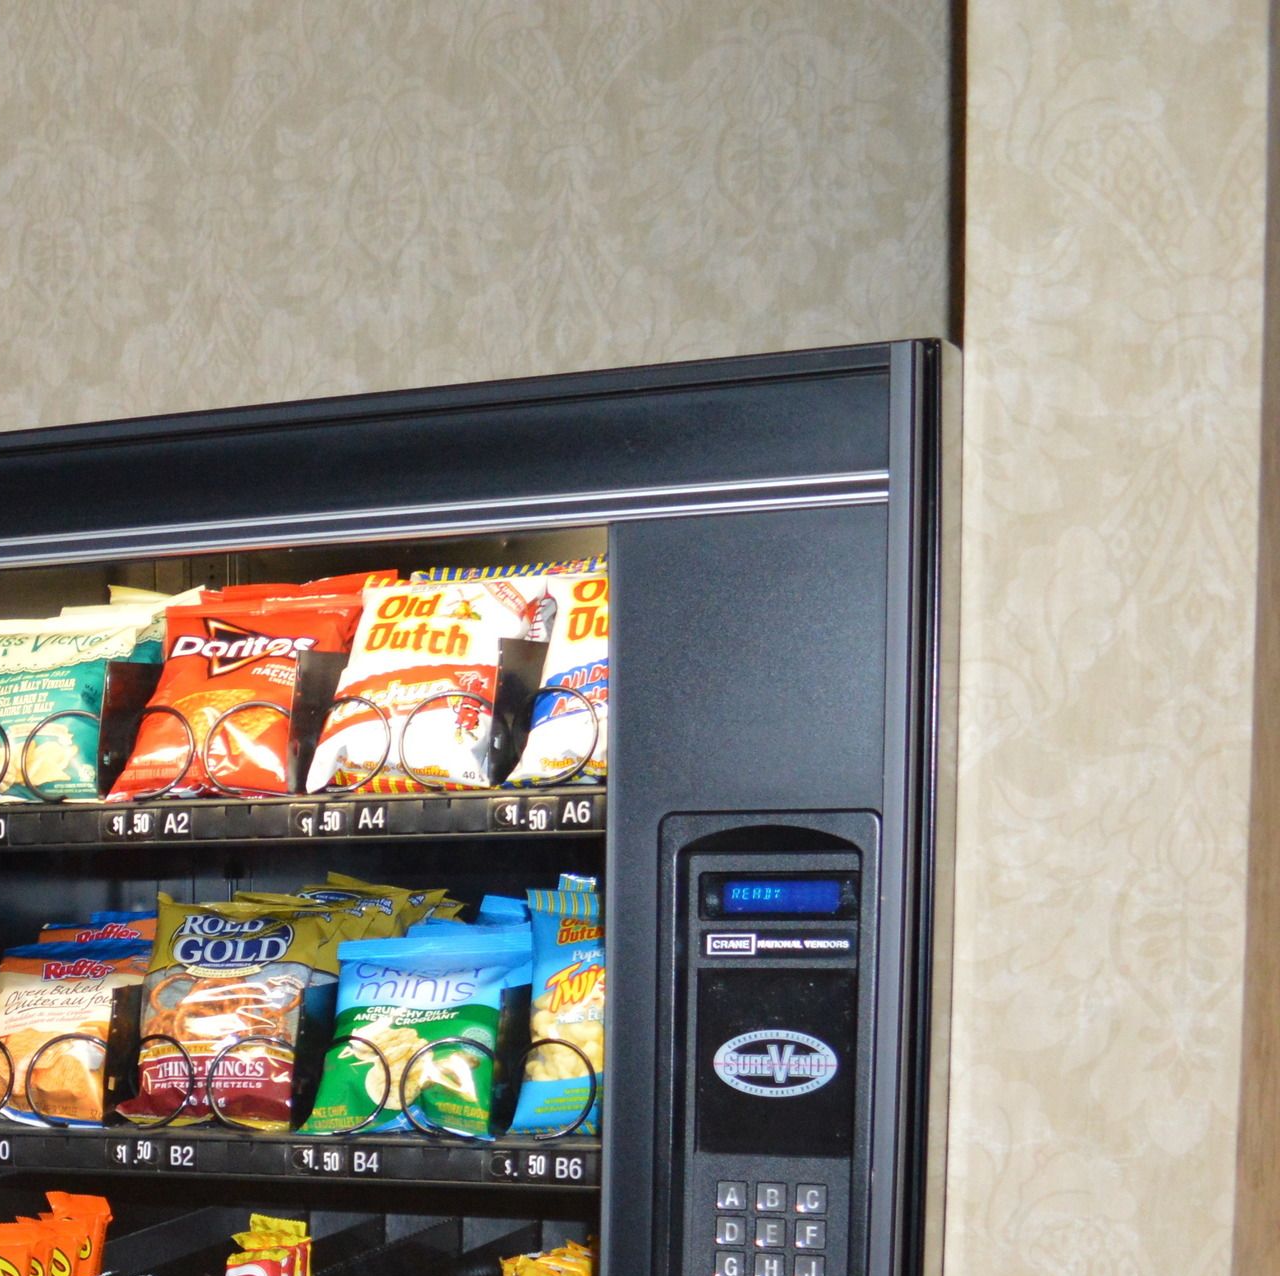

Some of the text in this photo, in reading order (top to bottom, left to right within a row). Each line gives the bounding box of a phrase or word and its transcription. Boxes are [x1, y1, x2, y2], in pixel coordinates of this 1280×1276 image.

[377, 593, 442, 620] Old
[171, 634, 317, 659] Doritos
[365, 622, 469, 657] Dutch
[112, 812, 190, 836] $1.50 A2
[301, 807, 385, 837] $1.50 A4
[504, 801, 591, 831] $1.50 A6
[731, 887, 782, 901] READY
[173, 935, 288, 964] GOLD
[712, 939, 850, 950] CRANE NATIONAL VENDORS
[42, 958, 117, 982] Ruffles
[51, 979, 105, 996] Baked
[115, 1142, 195, 1167] $1.50 B2
[302, 1149, 380, 1174] $1.50 B4
[554, 1158, 583, 1180] B6
[724, 1187, 820, 1209] A B C
[725, 1223, 818, 1245] D E F
[724, 1257, 738, 1276] G
